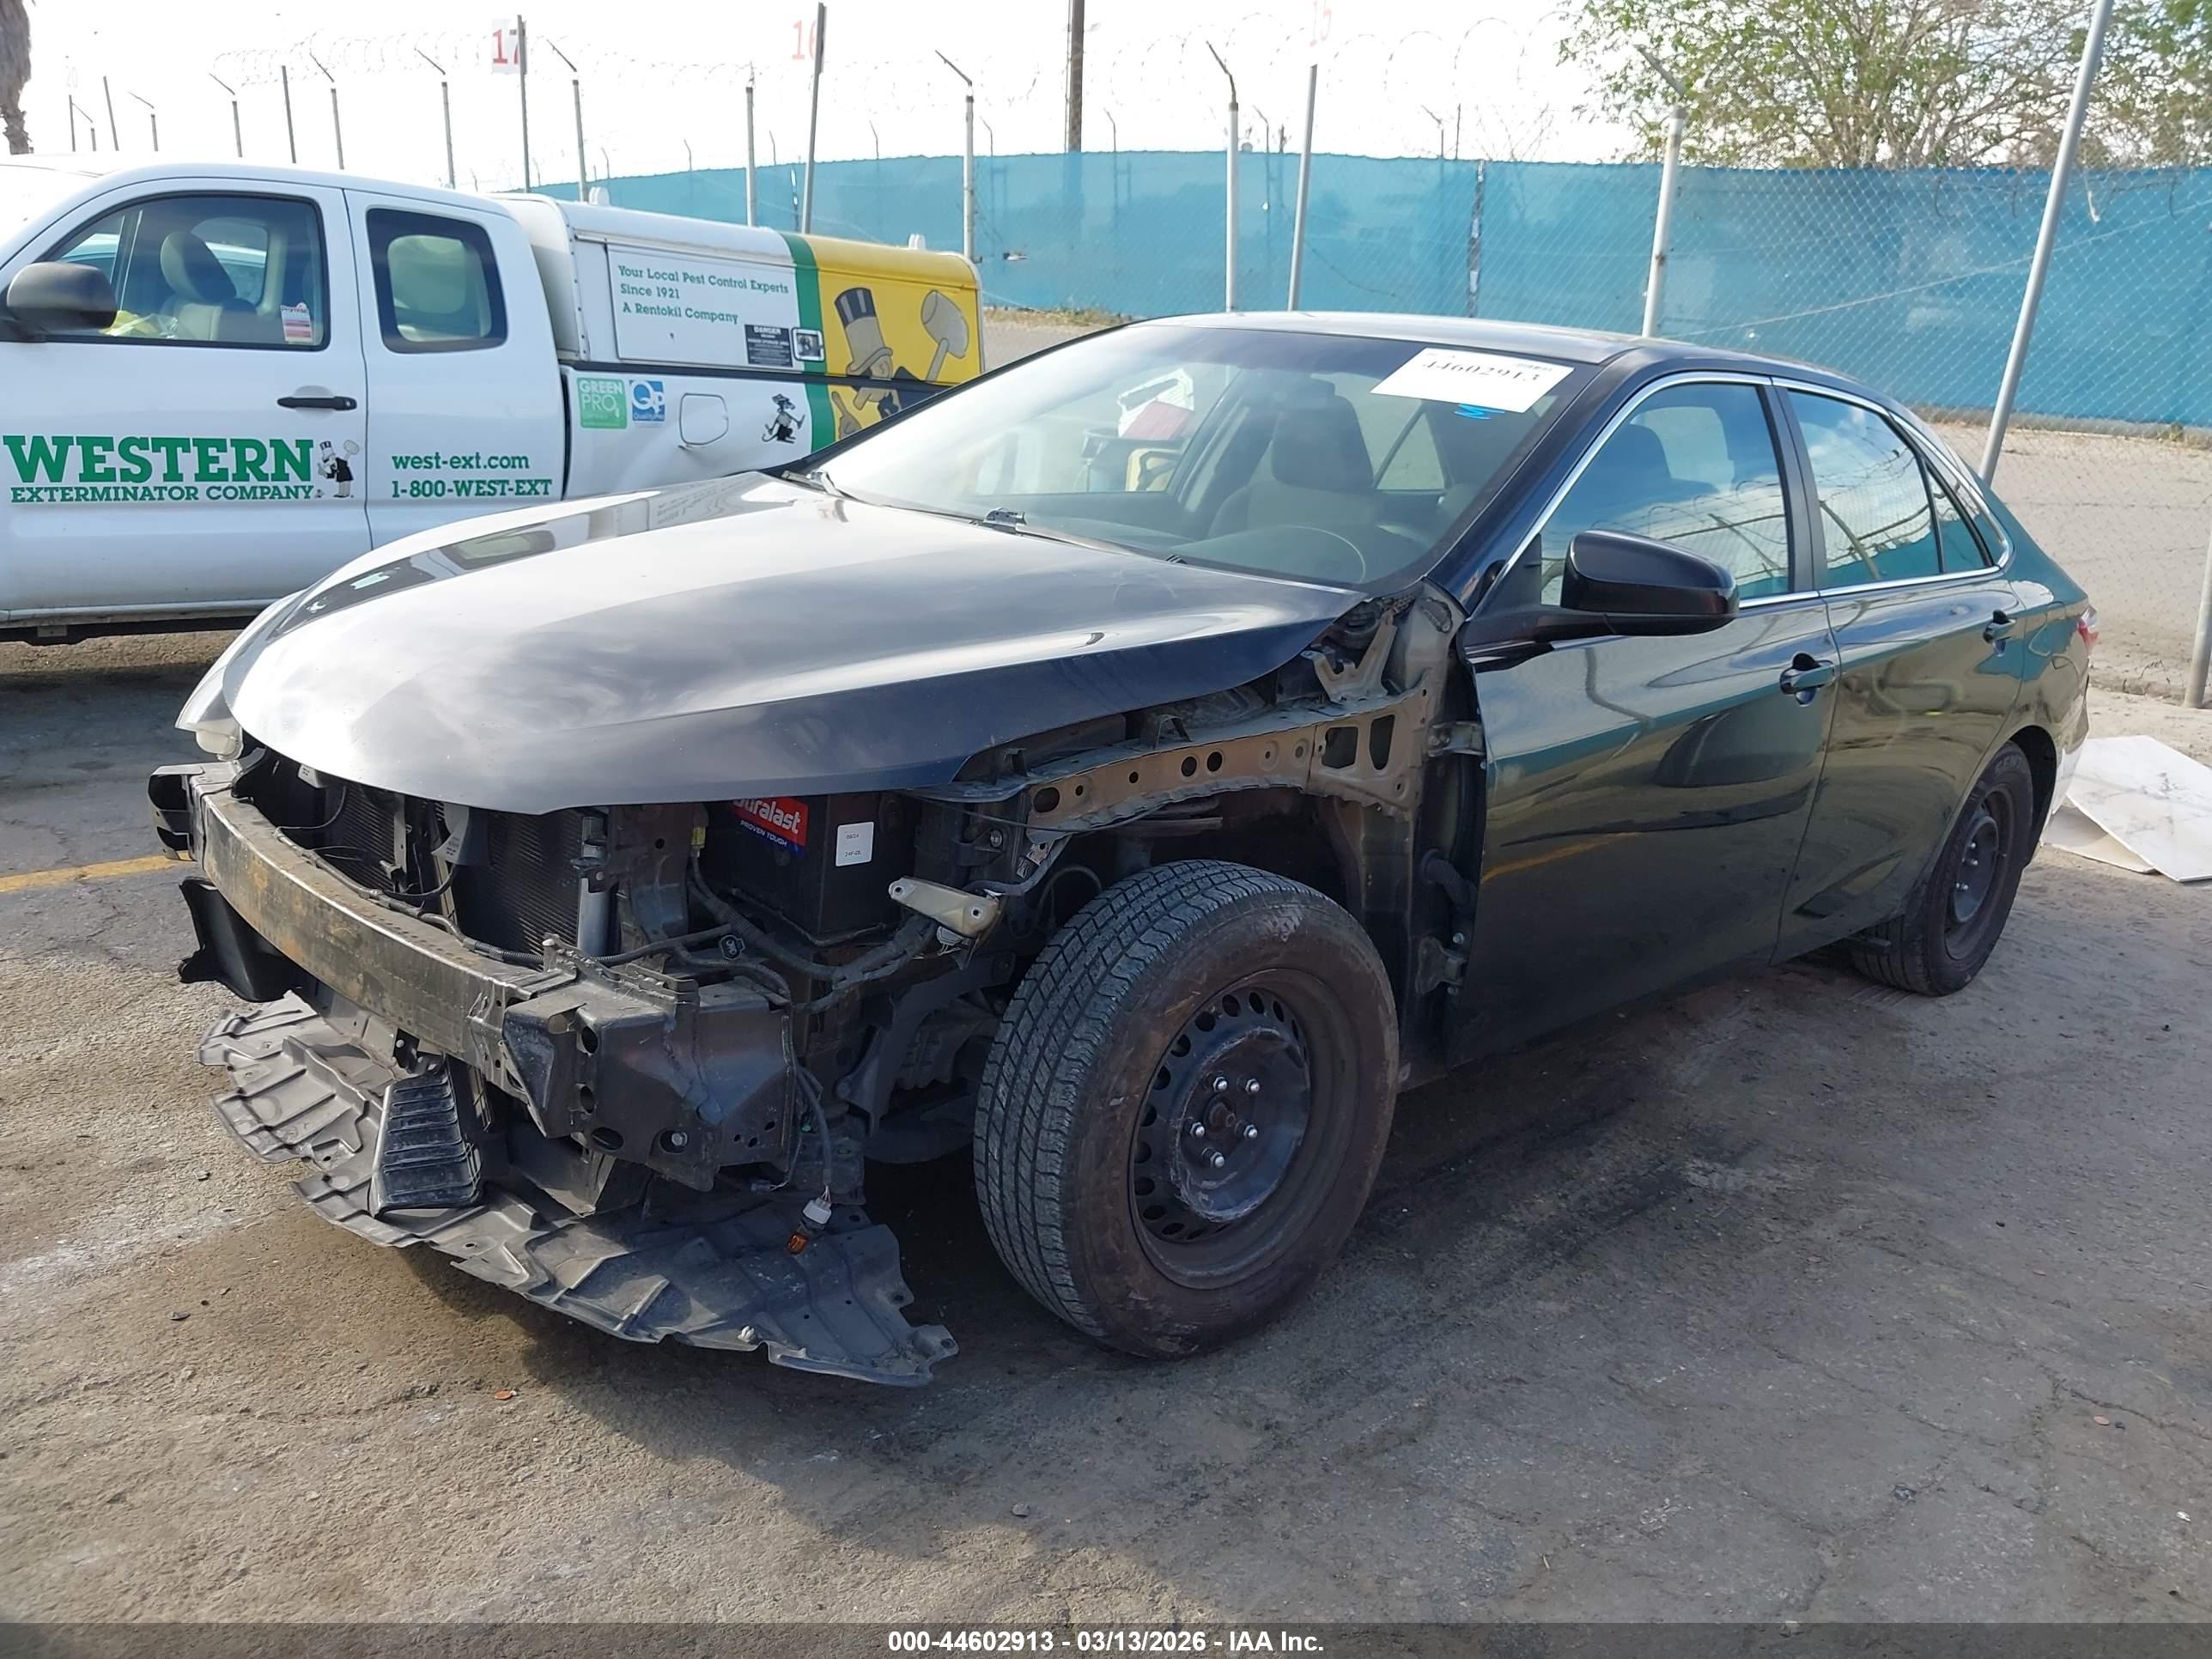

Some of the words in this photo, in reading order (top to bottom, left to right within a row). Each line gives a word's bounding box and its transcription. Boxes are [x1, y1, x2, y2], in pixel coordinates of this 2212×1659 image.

[618, 264, 644, 279] Your
[647, 268, 679, 283] Local
[682, 272, 705, 285] Pest
[708, 275, 747, 290] Control
[750, 280, 789, 295] Experts
[620, 283, 653, 297] Since
[655, 286, 680, 300] 1921
[623, 301, 631, 314] A
[635, 302, 682, 318] Rentokil
[685, 307, 738, 325] Company
[579, 380, 623, 394] GREEN
[580, 393, 617, 412] PRO
[3, 434, 314, 483] WESTERN
[391, 452, 530, 470] west-ext.com
[10, 484, 199, 503] EXTERMINATOR
[205, 483, 314, 501] COMPANY
[391, 478, 552, 498] 1-800-WEST-EXT
[740, 820, 766, 836] PROVEN
[766, 831, 787, 848] TOUGH
